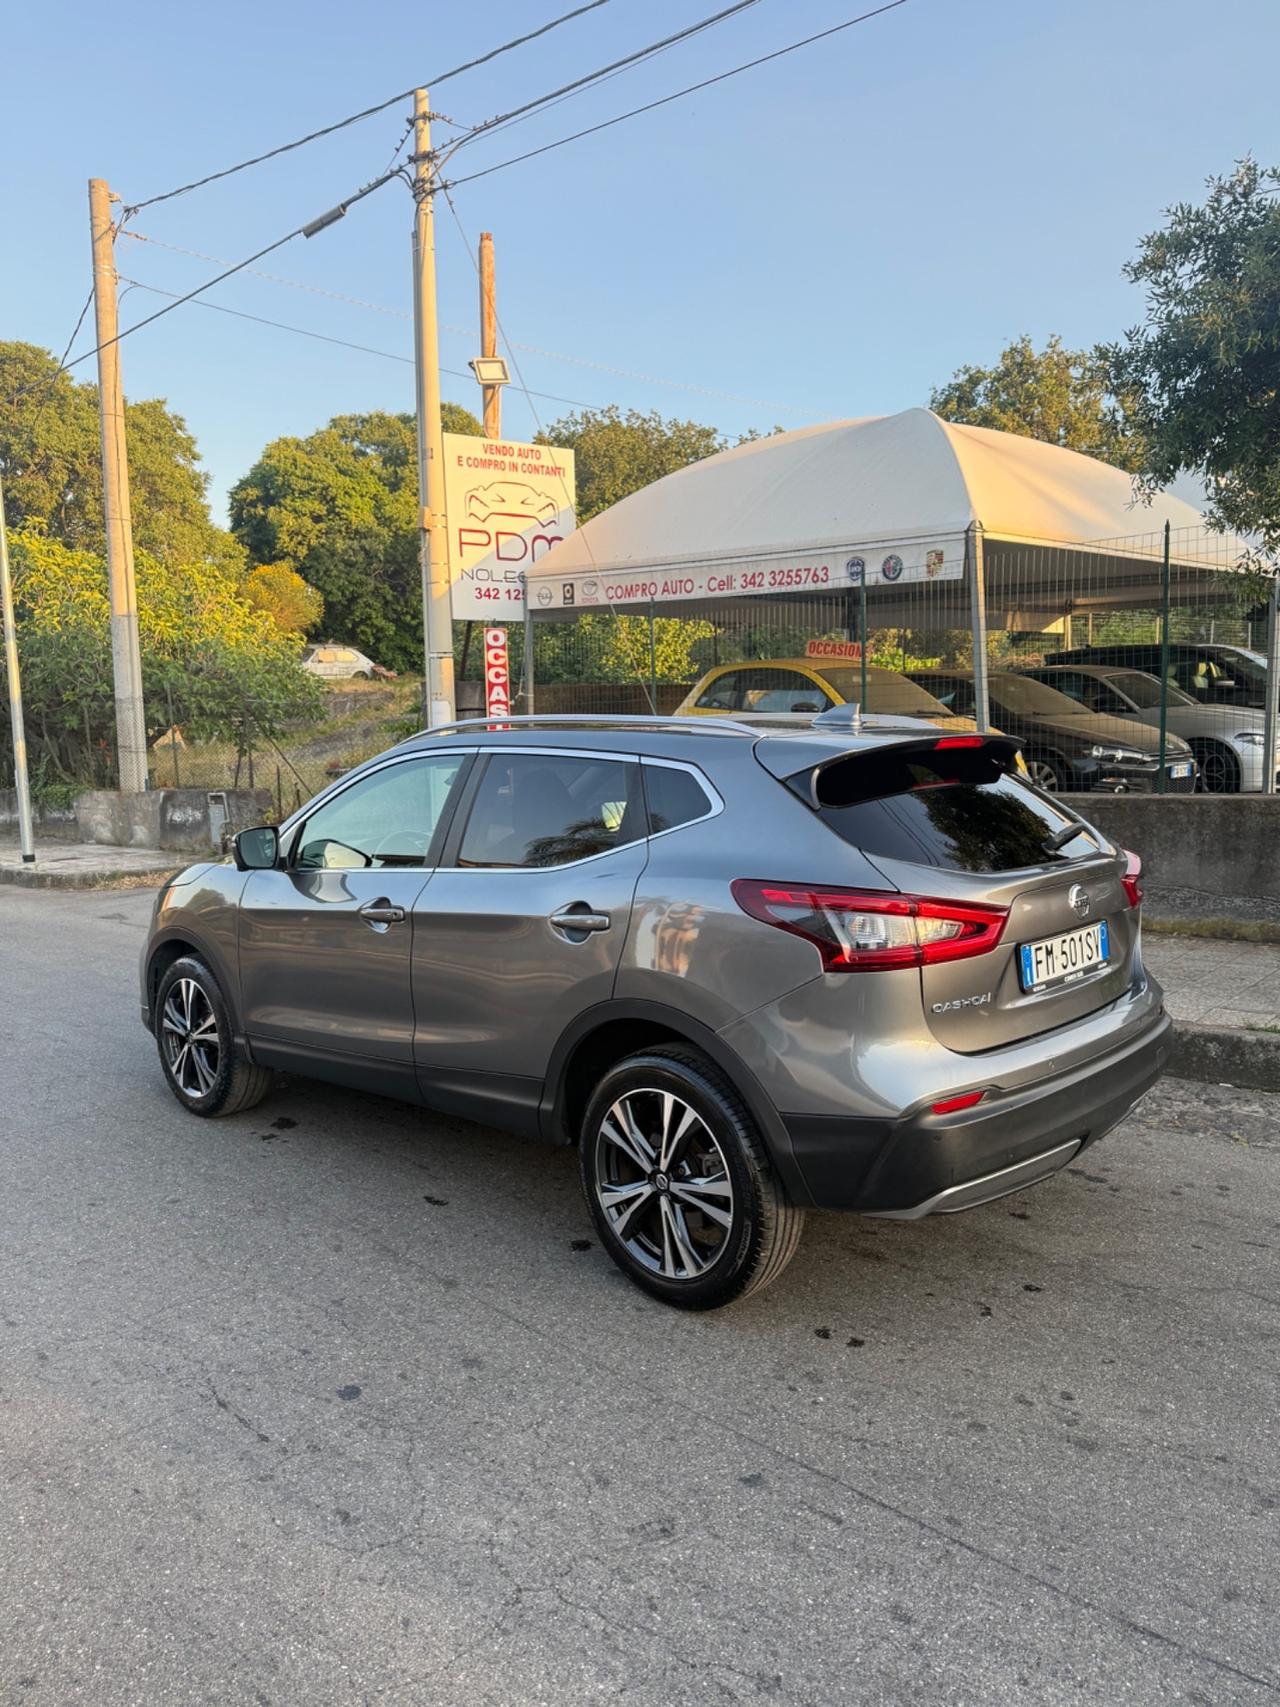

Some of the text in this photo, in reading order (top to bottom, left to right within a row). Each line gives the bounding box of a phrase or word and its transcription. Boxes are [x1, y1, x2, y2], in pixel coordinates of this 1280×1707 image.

[482, 443, 542, 460] VENDO AUTO
[457, 455, 566, 478] E COMPRO IN CONTANTI
[606, 582, 657, 600] COMPRO
[661, 578, 694, 596] AUTO
[707, 575, 736, 592] Cell:
[740, 573, 764, 589] 342
[768, 566, 829, 587] 3255763
[475, 587, 501, 600] 342
